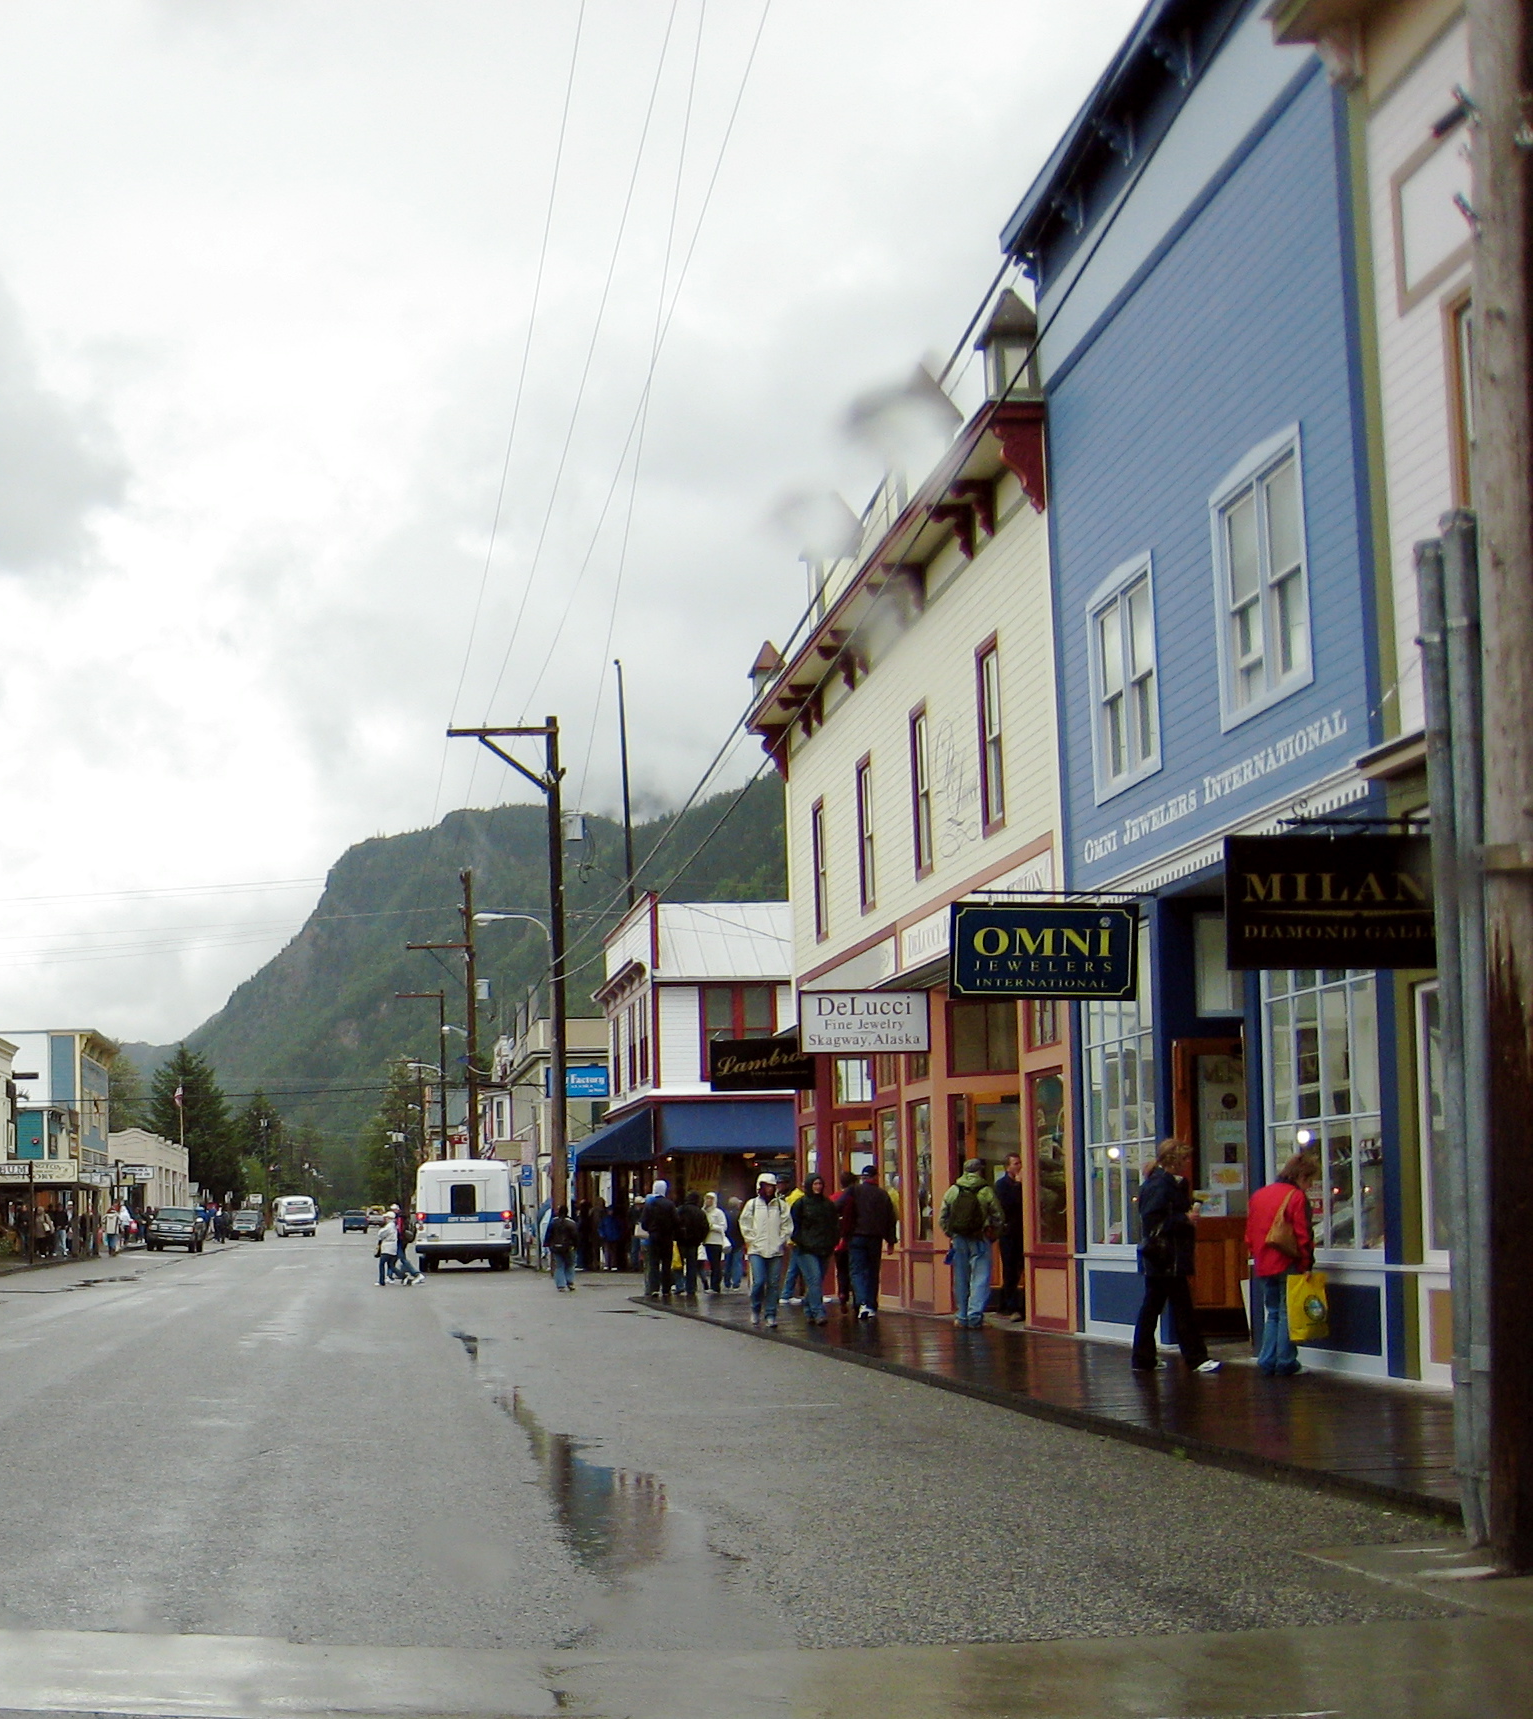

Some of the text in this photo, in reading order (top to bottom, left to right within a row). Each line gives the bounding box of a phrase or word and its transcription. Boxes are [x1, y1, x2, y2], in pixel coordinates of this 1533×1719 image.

[1084, 709, 1348, 865] OMNI JEWELERS INTERNATIONAL
[1242, 872, 1433, 902] MILAN
[1244, 924, 1435, 940] DIAMOND GALL
[974, 960, 1113, 973] JEWELERS
[976, 977, 1109, 989] INTERNATIONAL
[817, 995, 913, 1016] DeLucci
[825, 1018, 905, 1031] Fine Jewelry
[808, 1033, 921, 1048] Skagway, Alaska
[570, 1073, 606, 1085] Factory
